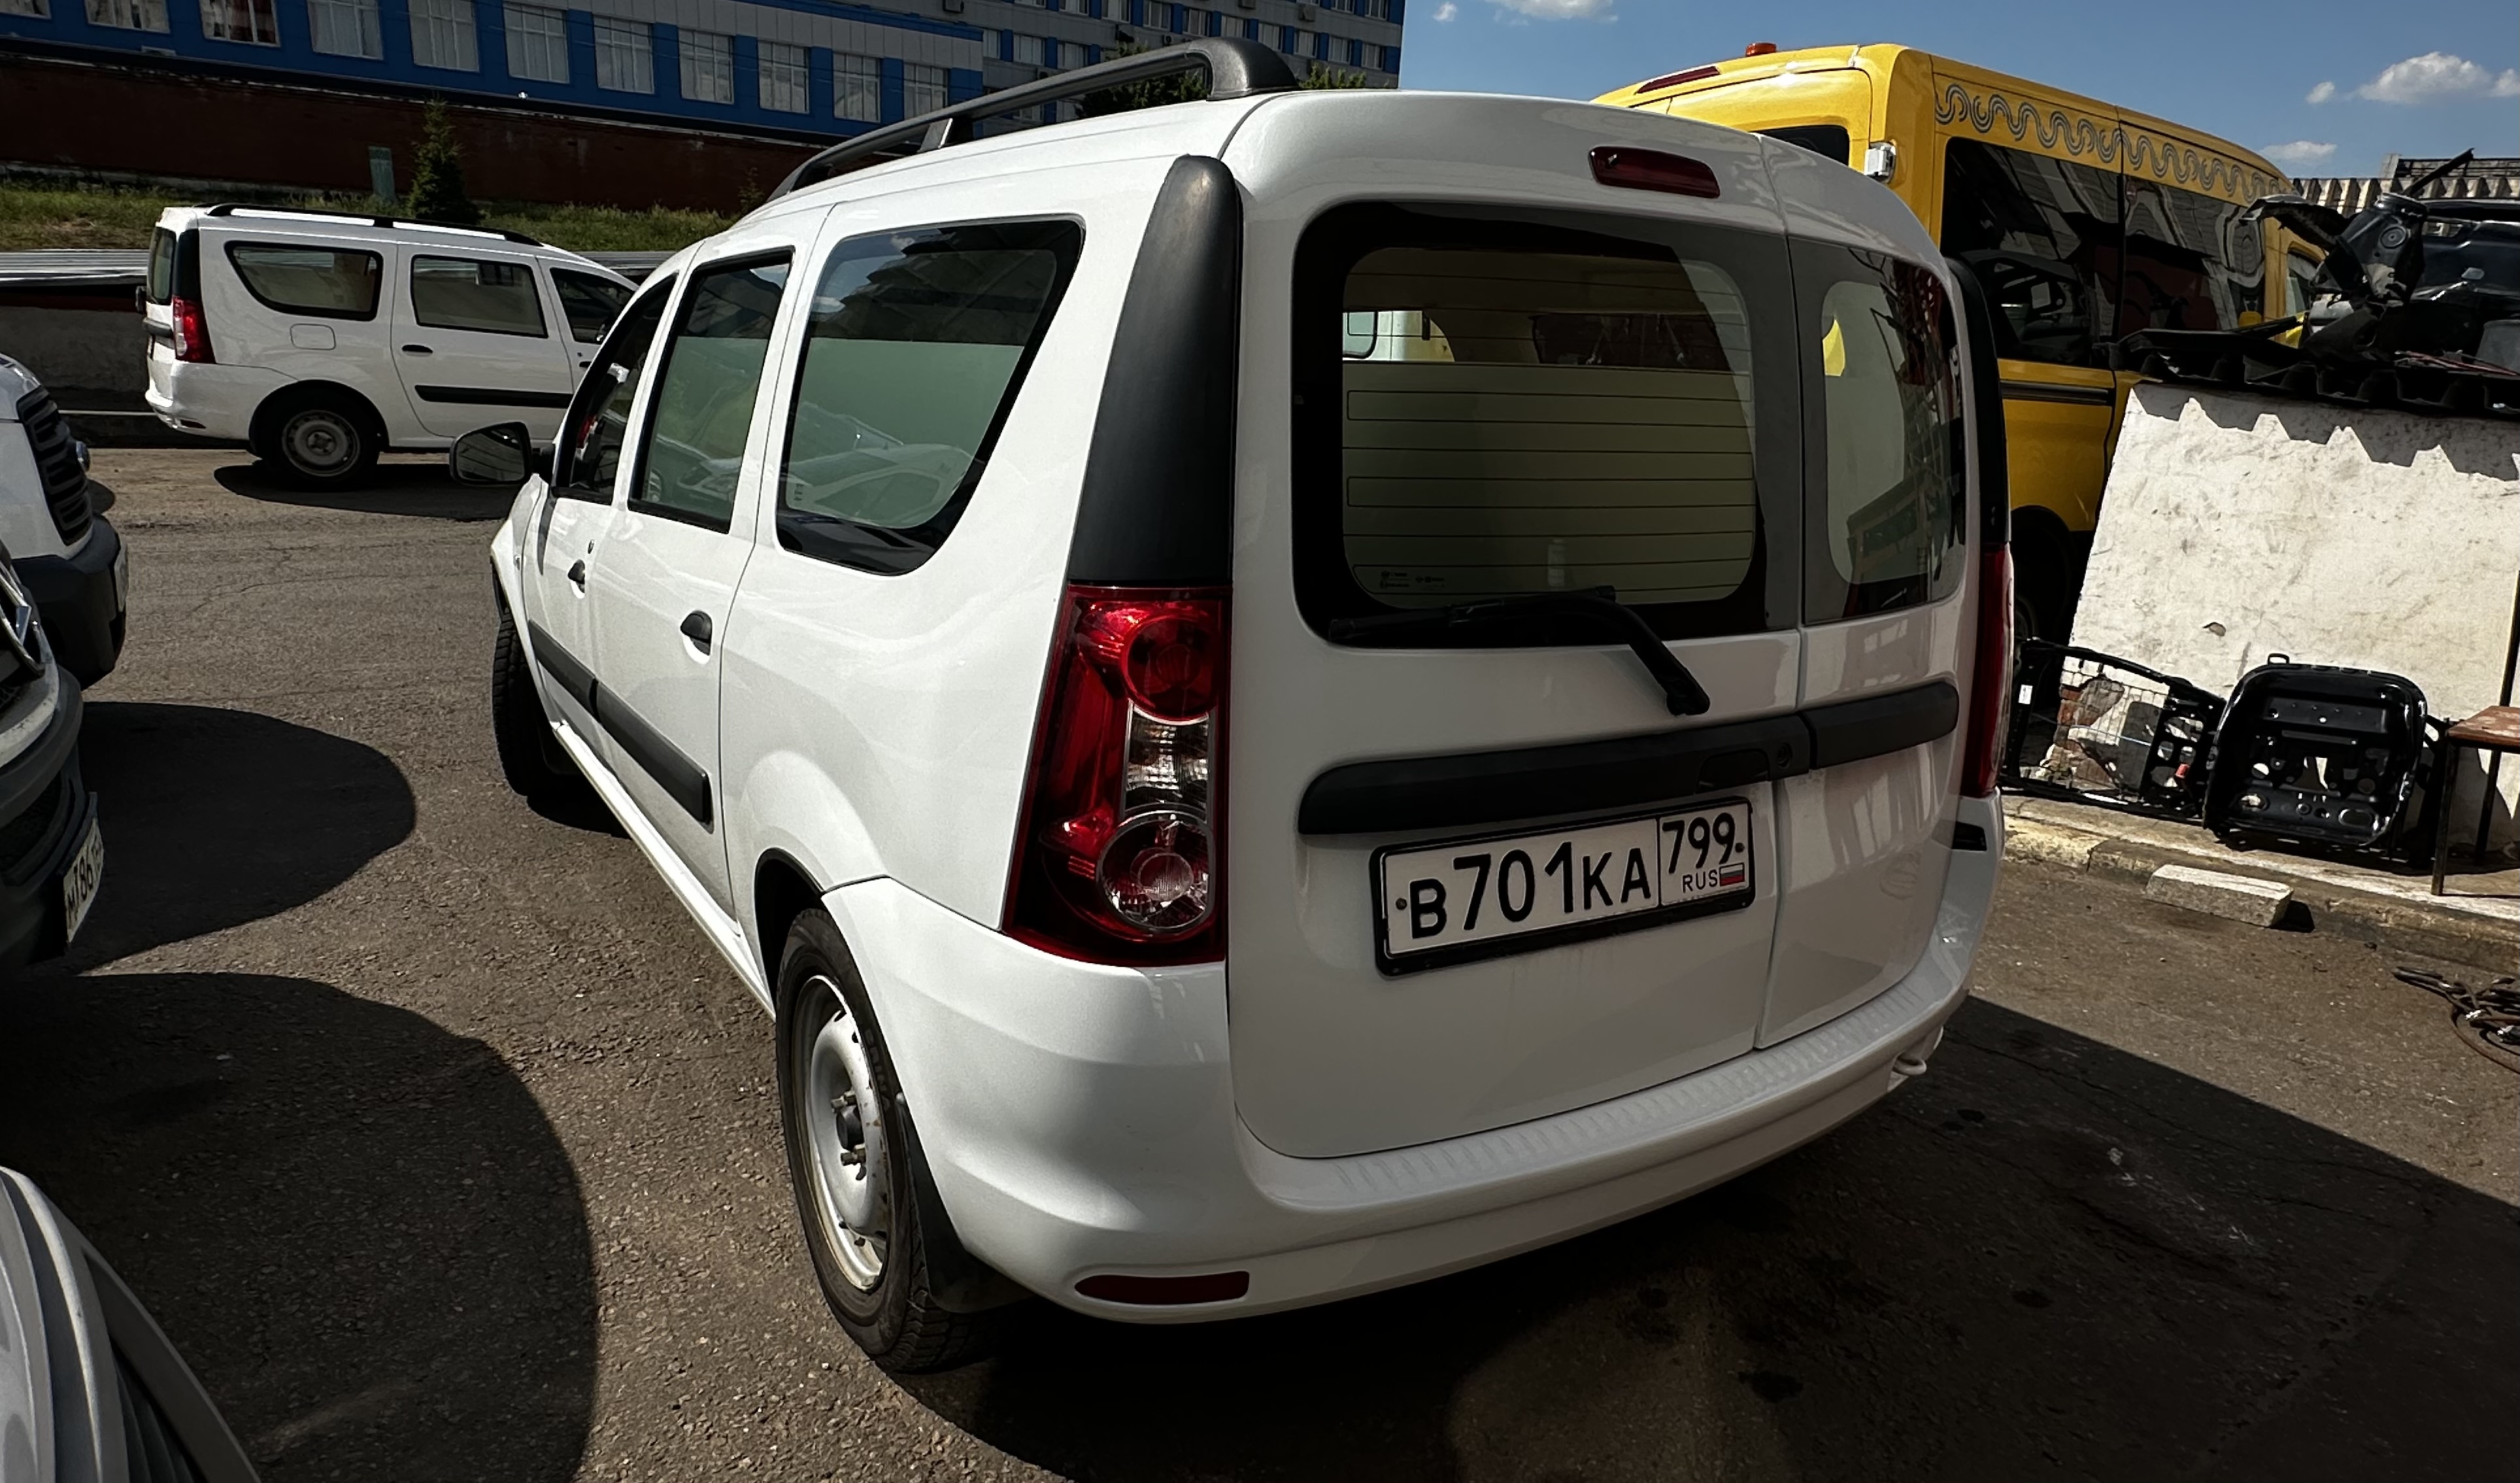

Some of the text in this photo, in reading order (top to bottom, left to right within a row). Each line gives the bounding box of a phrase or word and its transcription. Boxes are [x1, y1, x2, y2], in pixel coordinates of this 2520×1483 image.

[1409, 812, 1736, 938] В701КА 799
[1682, 869, 1718, 893] RUS
